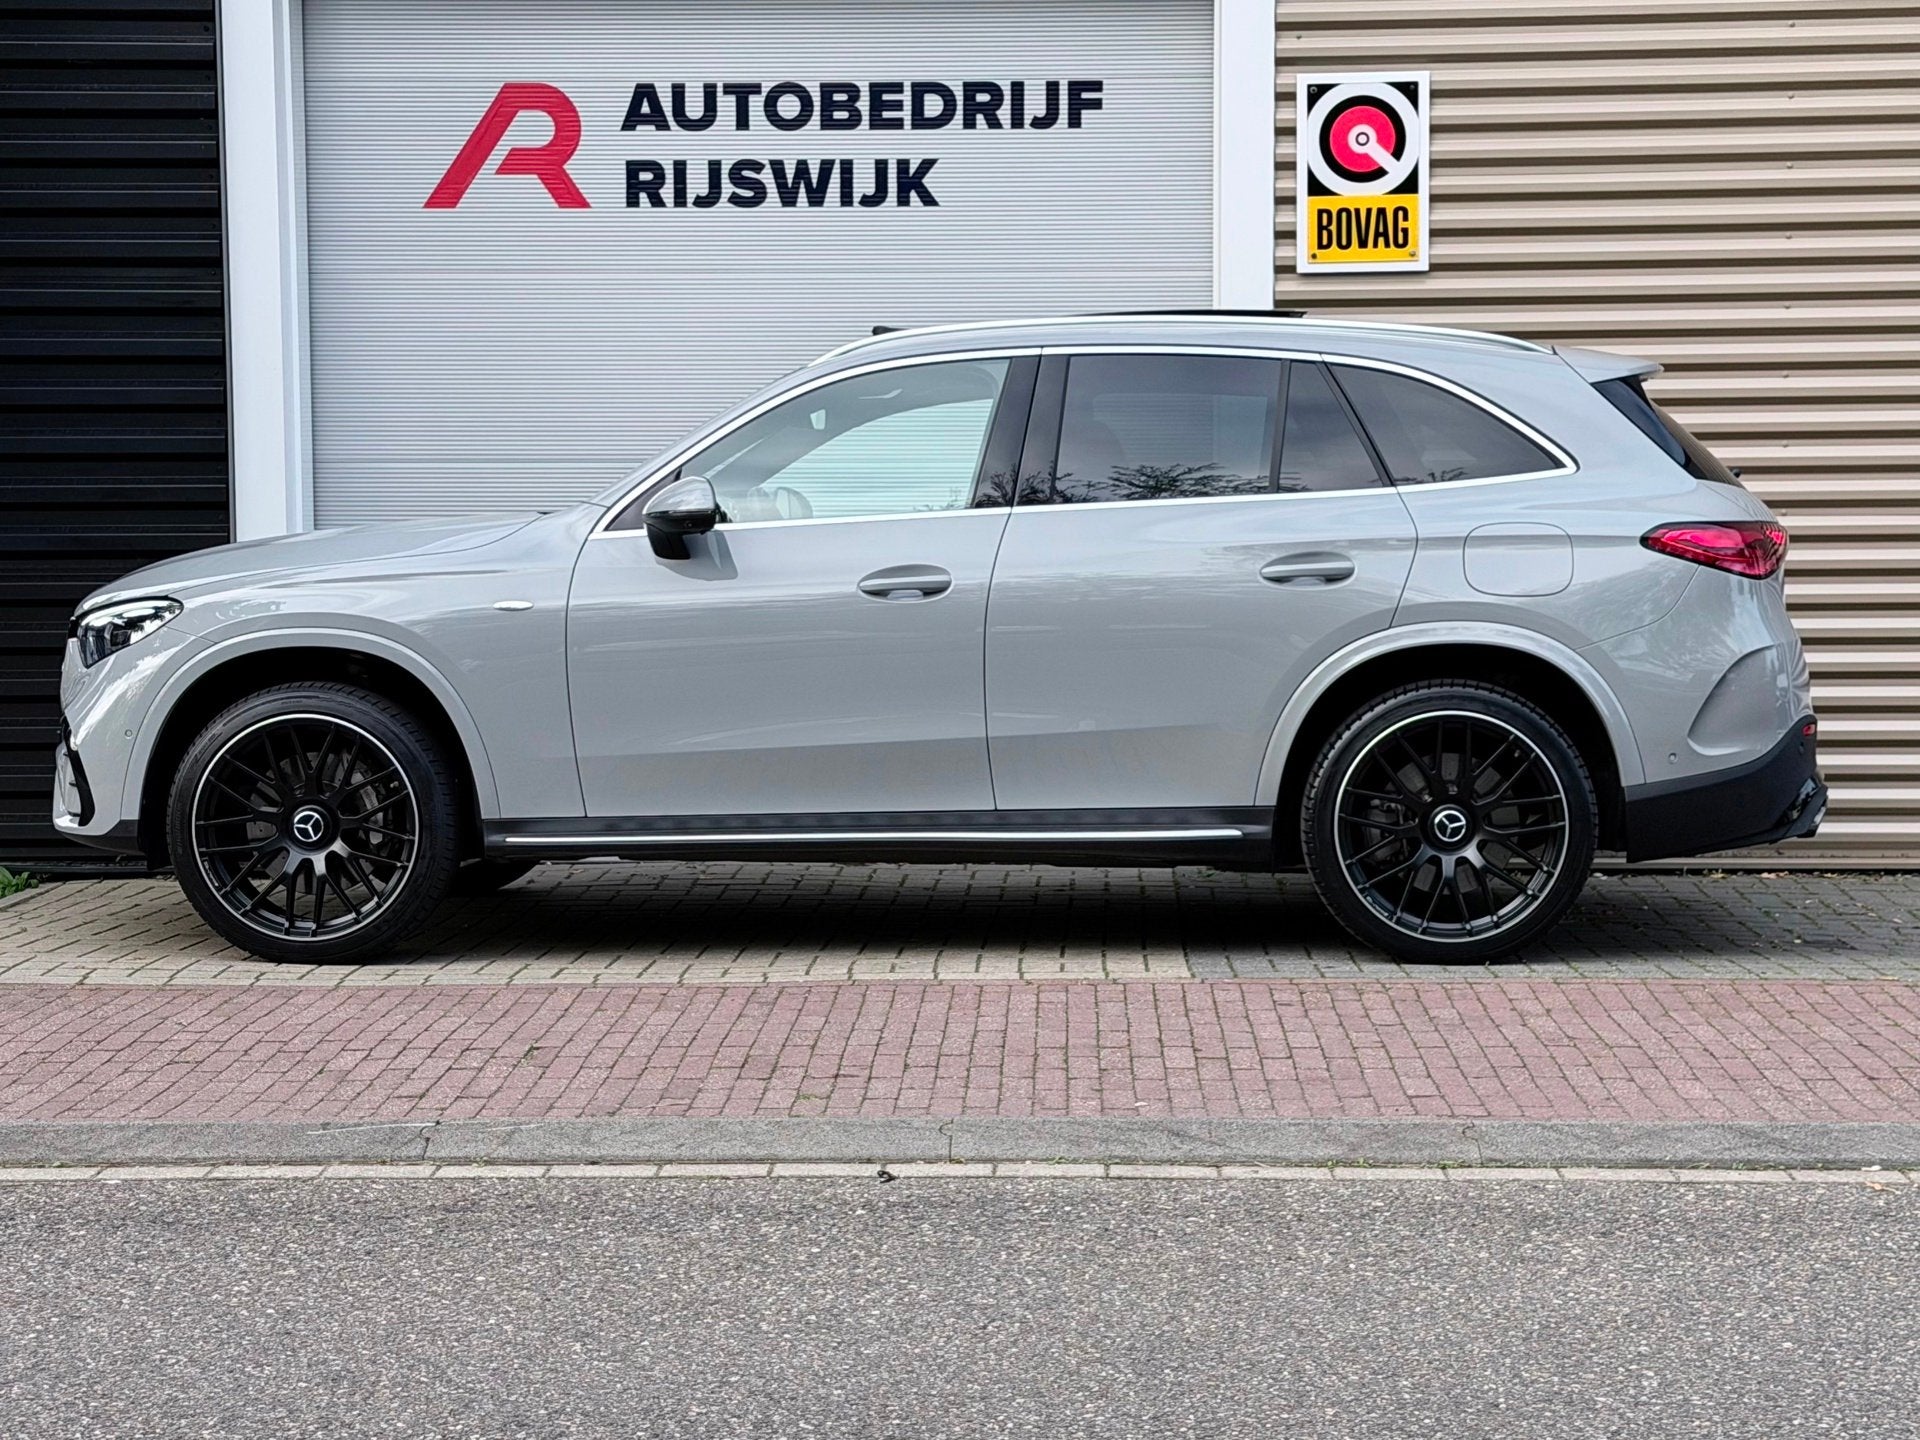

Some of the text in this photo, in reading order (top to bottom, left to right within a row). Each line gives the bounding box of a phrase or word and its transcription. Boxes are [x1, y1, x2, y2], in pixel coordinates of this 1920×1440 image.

[621, 80, 1104, 132] AUTOBEDRIJF
[626, 158, 939, 208] RIJSWIJK
[1317, 205, 1409, 251] BOVAG
